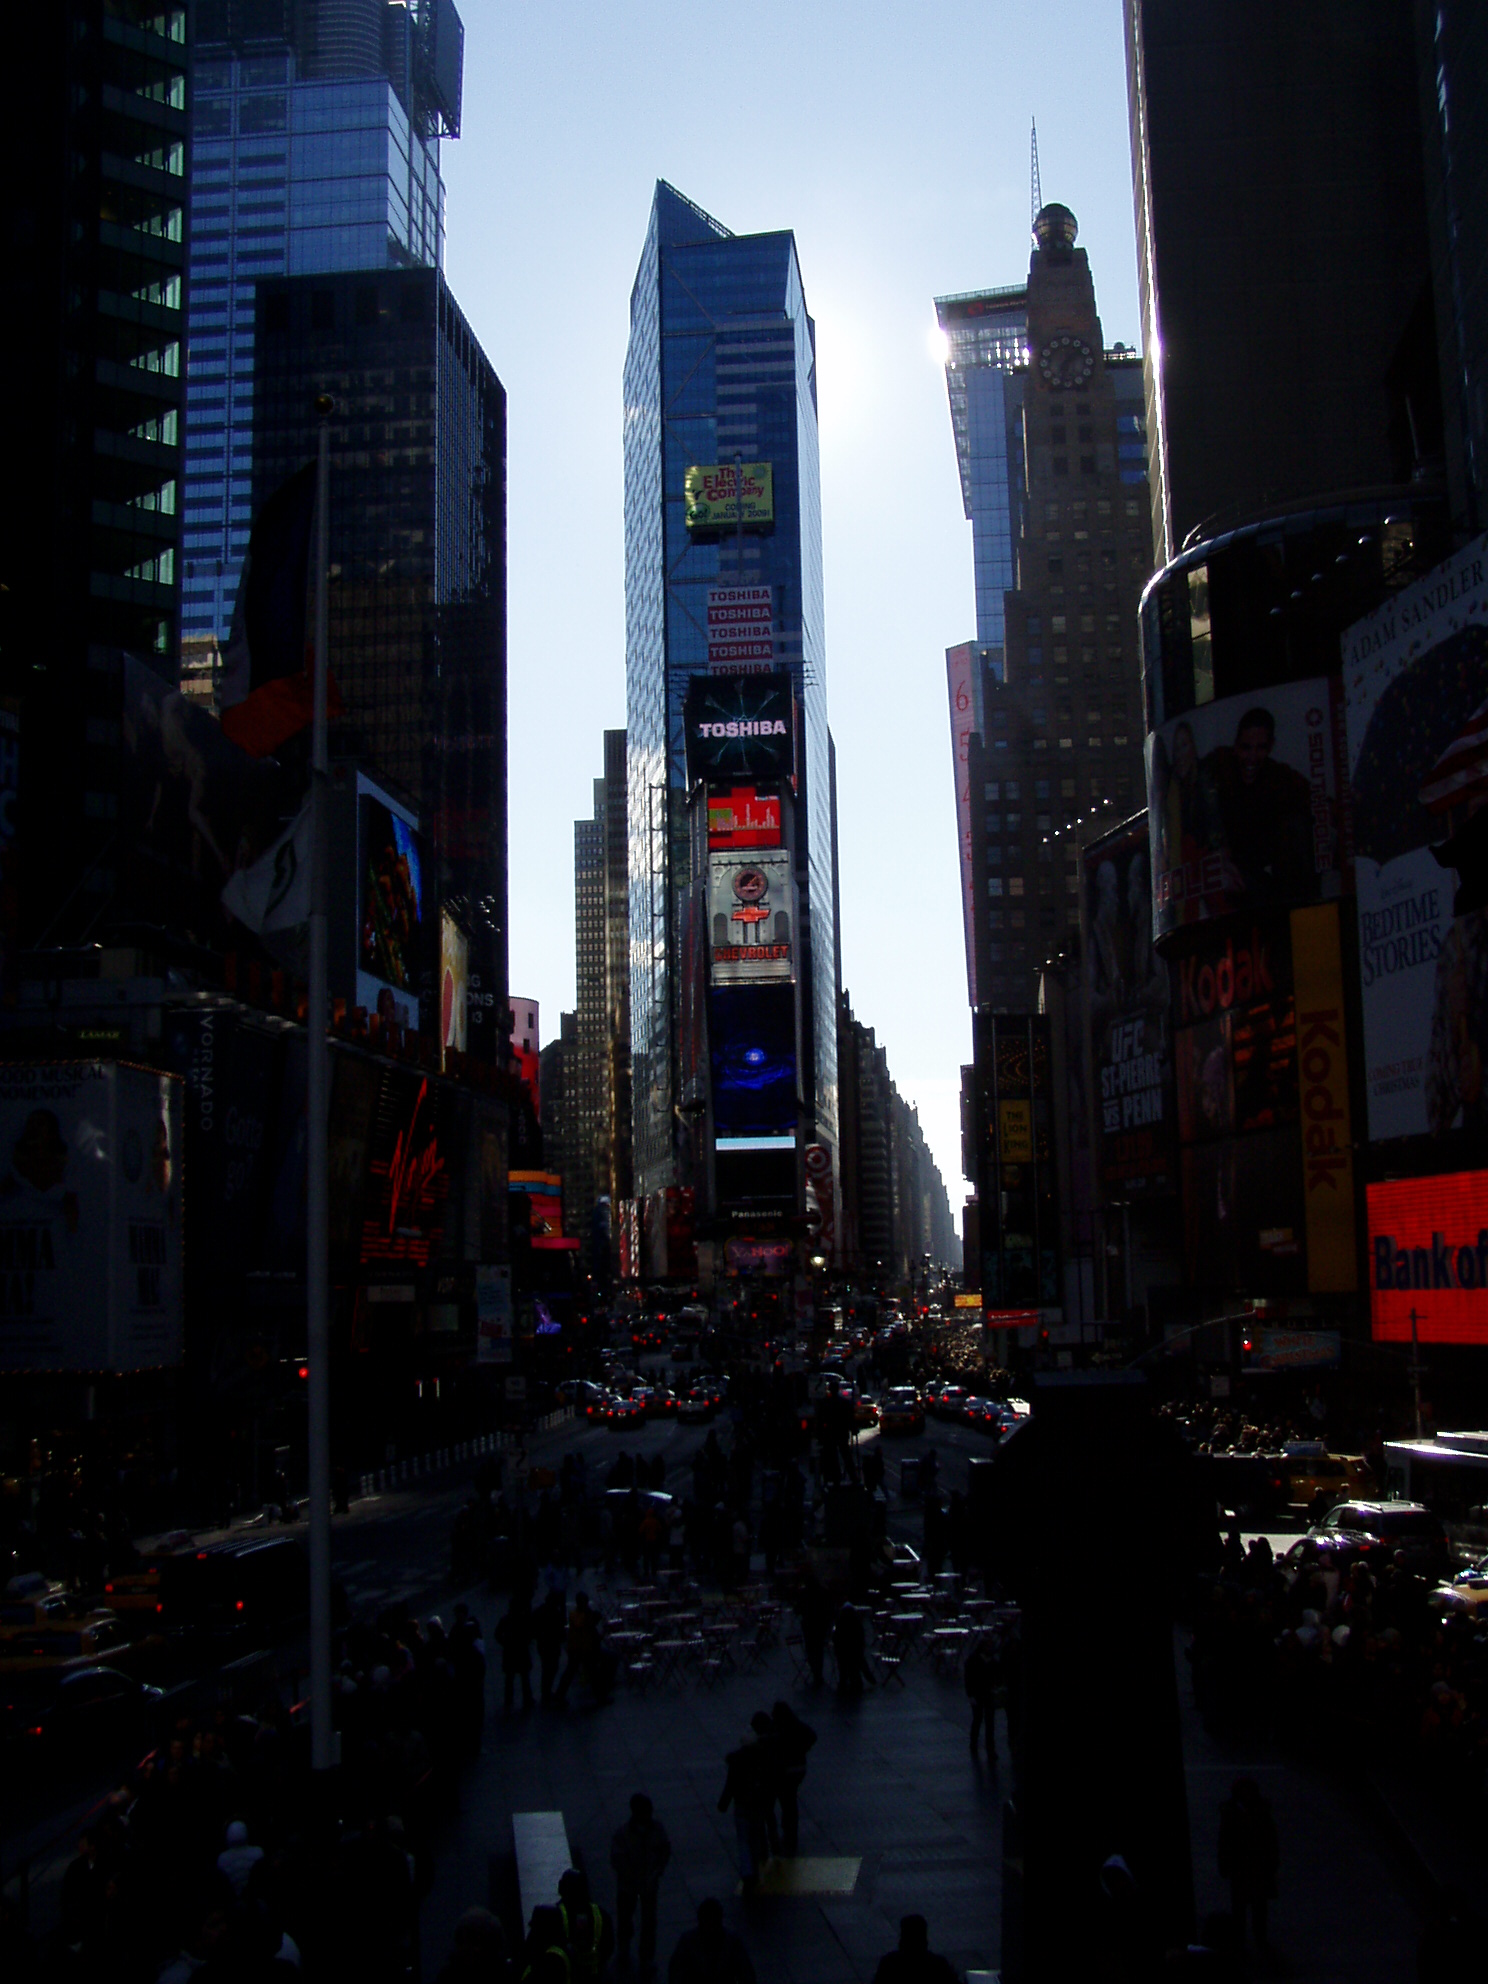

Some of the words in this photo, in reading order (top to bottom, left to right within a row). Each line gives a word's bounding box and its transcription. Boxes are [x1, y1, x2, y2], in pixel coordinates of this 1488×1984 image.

[709, 590, 770, 602] TOSHIBA
[710, 608, 770, 620] TOSHIBA
[1351, 616, 1397, 666] ADAM
[1401, 560, 1484, 634] SANDLER
[711, 627, 771, 639] TOSHIBA
[711, 645, 771, 657] TOSHIBA
[711, 664, 772, 675] TOSHIBA
[699, 719, 787, 738] TOSHIBA
[1361, 889, 1440, 949] BEDTIME
[715, 945, 789, 961] CHEVROLET
[1363, 924, 1442, 986] STORIES
[1178, 927, 1275, 1023] Kodak
[1111, 1018, 1145, 1064] UFC
[42, 1062, 104, 1083] MUSICAL
[200, 1015, 214, 1132] VORNADO
[1122, 1087, 1163, 1129] PENN
[1300, 1009, 1348, 1192] Kodak
[731, 1210, 784, 1219] Panasonic
[731, 1245, 789, 1258] YAHOO!
[1375, 1231, 1458, 1291] Bank
[1458, 1229, 1488, 1290] of
